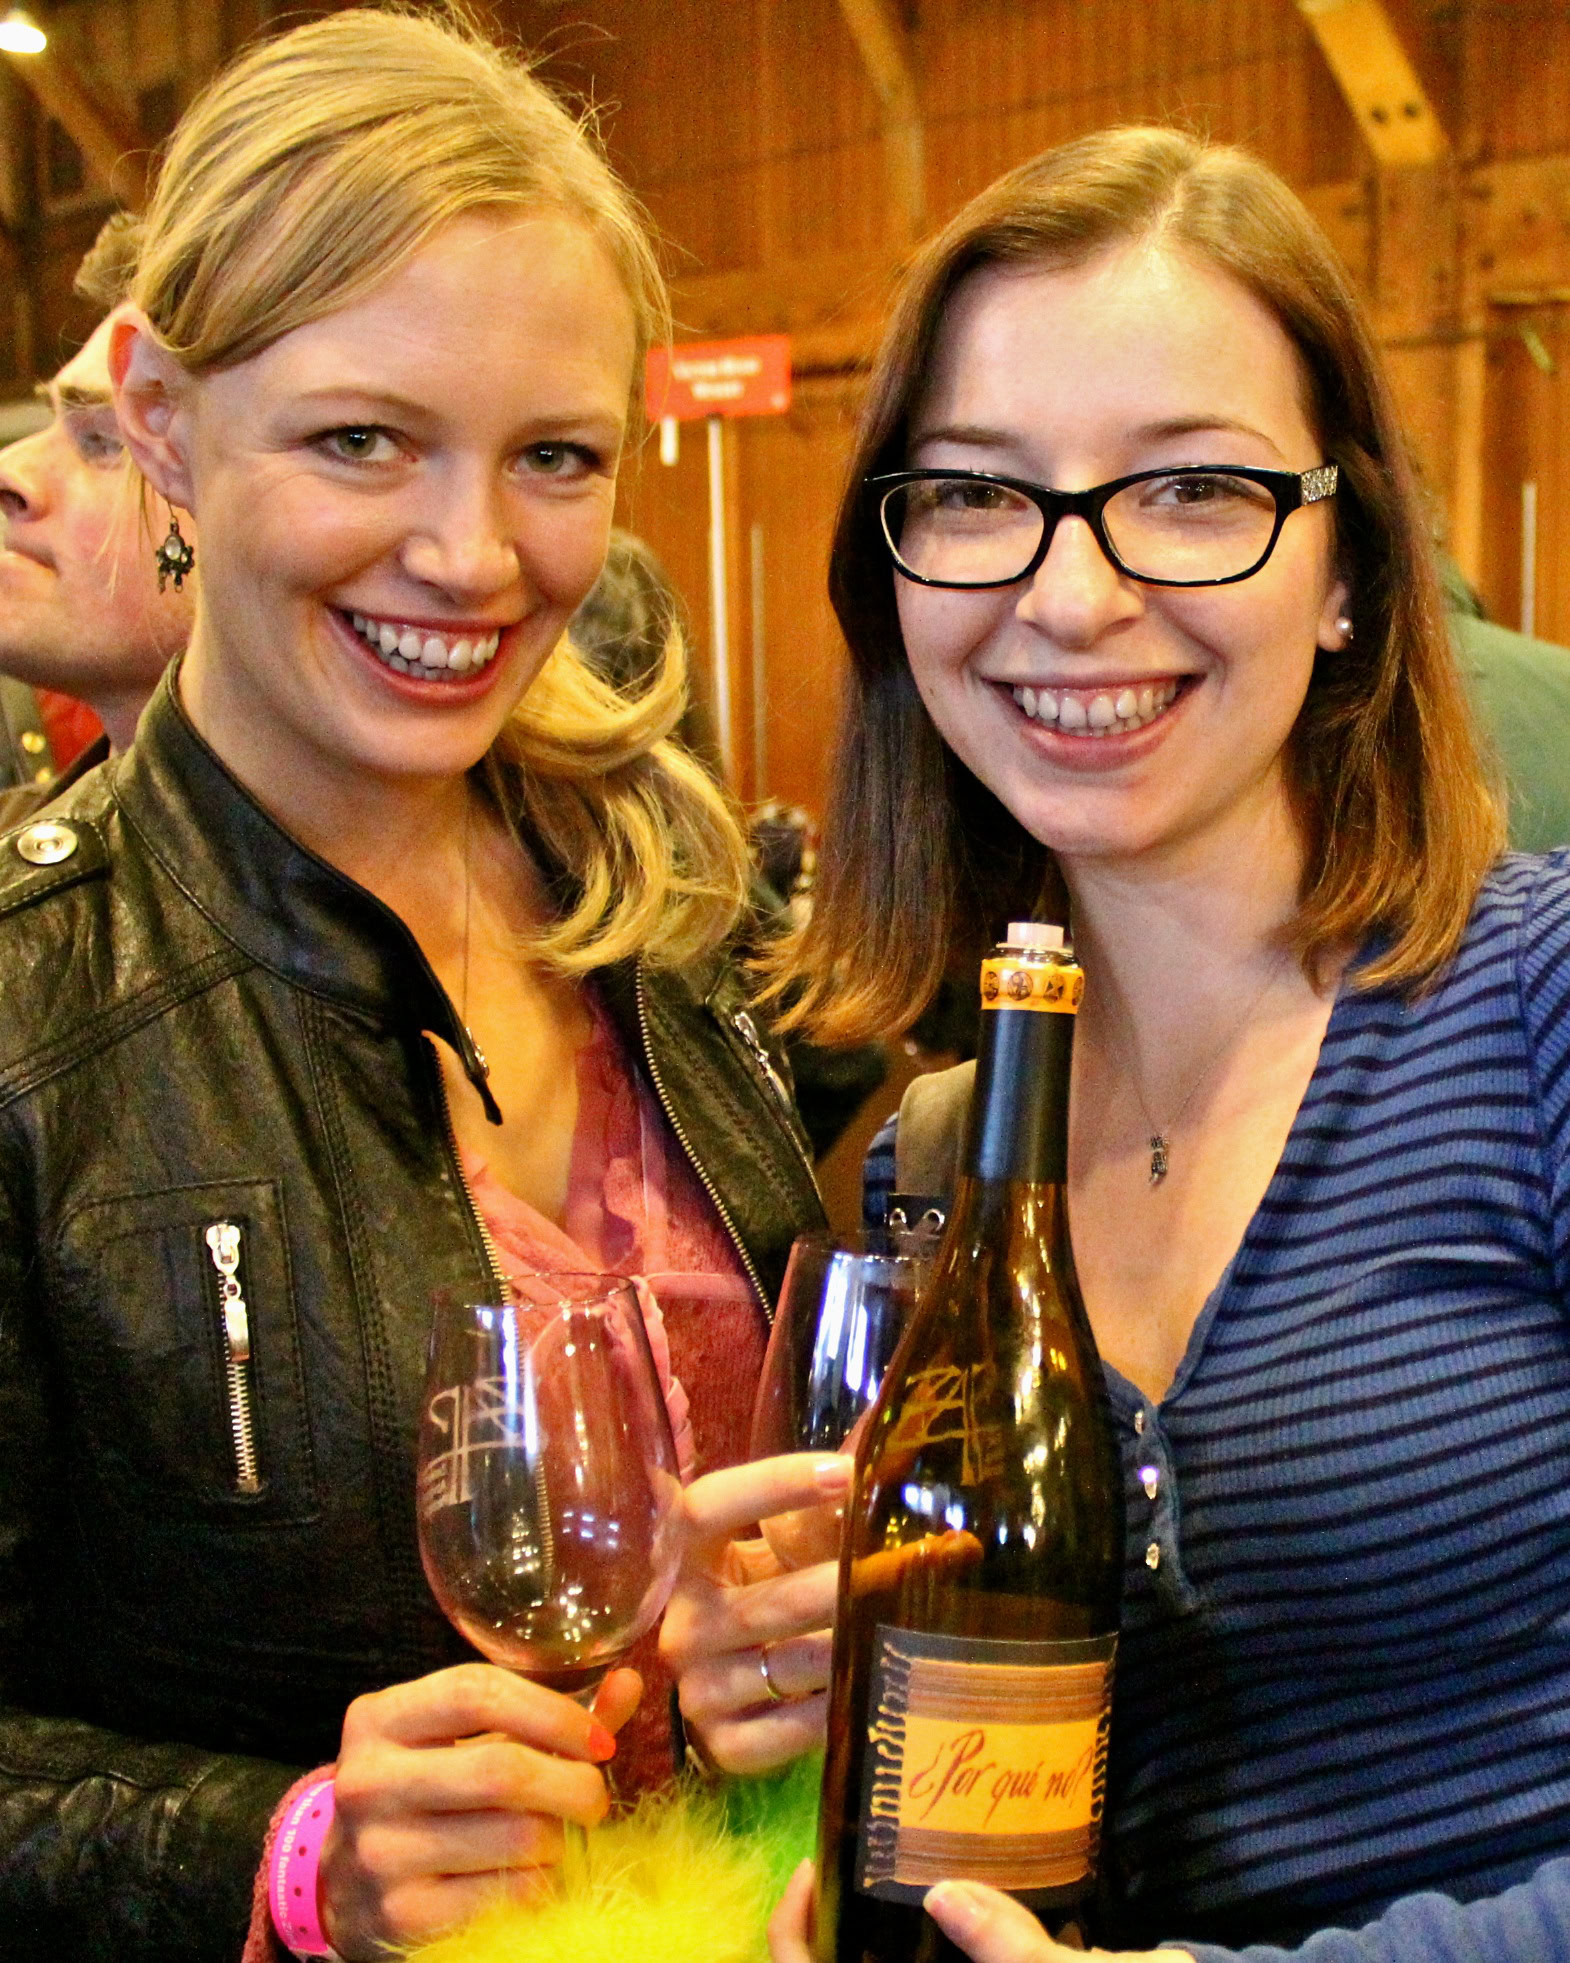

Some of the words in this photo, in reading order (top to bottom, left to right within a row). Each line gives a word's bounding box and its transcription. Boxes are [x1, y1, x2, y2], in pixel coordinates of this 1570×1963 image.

[907, 1728, 996, 1822] ¿Por
[990, 1760, 1046, 1830] qué
[1044, 1745, 1094, 1809] no?
[290, 1797, 314, 1826] than
[281, 1828, 297, 1854] 100
[276, 1855, 291, 1920] fantastic
